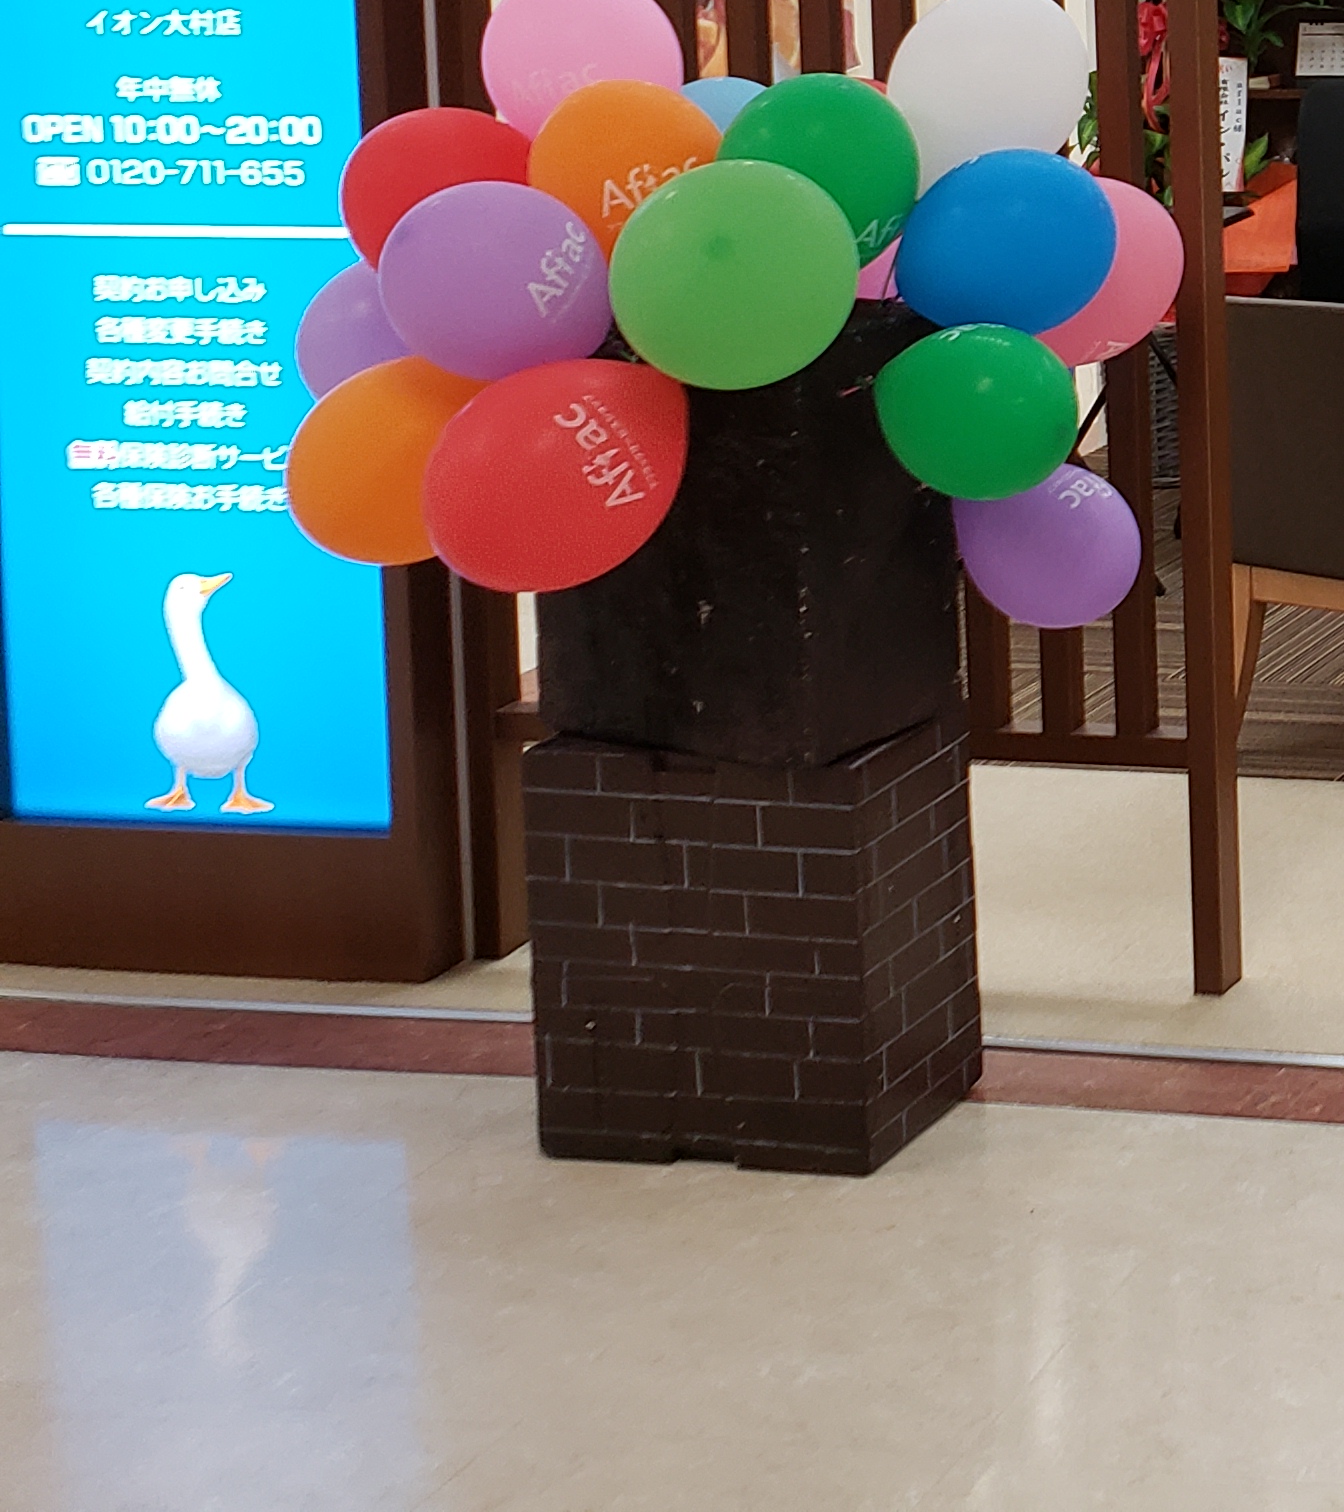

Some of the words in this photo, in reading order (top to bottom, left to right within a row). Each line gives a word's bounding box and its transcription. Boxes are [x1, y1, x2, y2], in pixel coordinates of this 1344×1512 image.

[86, 9, 243, 36] イオン大村店
[115, 76, 222, 103] 年中無休
[21, 115, 104, 143] OPEN
[86, 159, 306, 187] 0120-711-655
[525, 222, 588, 318] Aflac
[553, 402, 642, 510] Aflac
